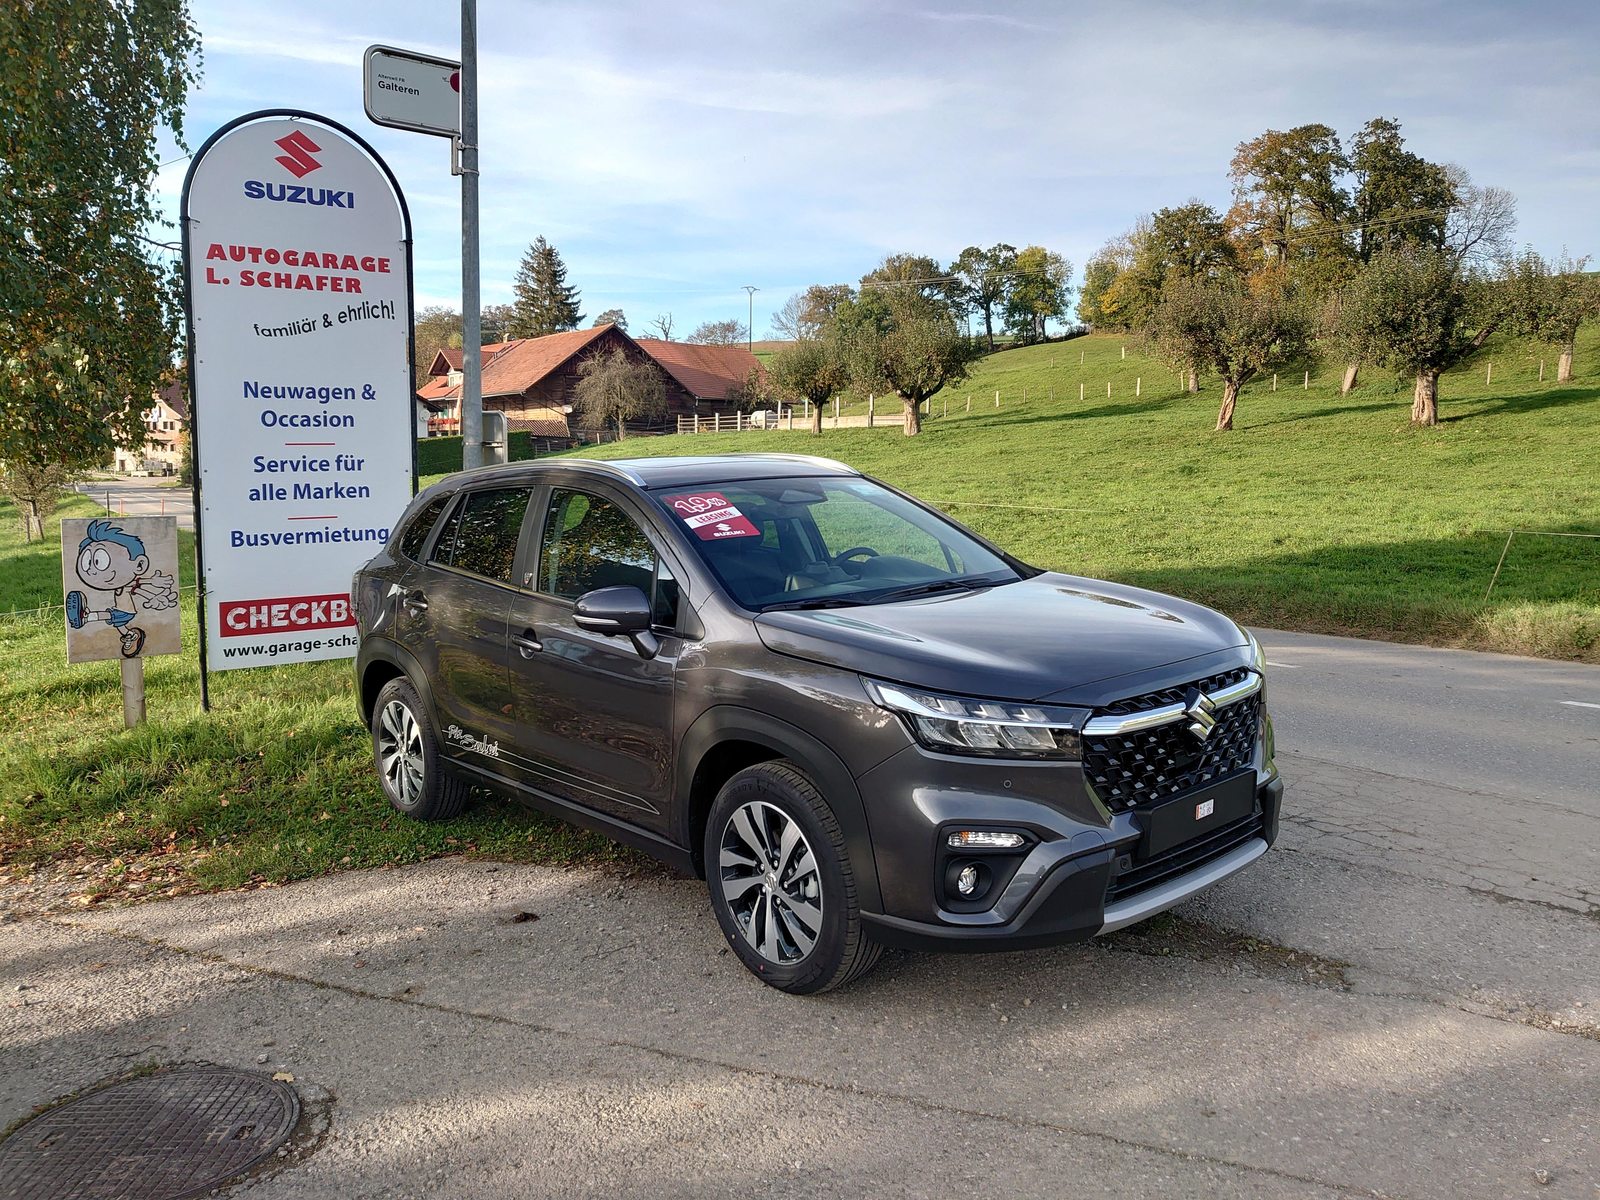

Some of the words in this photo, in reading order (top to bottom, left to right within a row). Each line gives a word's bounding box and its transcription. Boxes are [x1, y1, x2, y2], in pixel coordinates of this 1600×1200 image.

[378, 80, 420, 96] Galteren
[244, 180, 355, 209] SUZUKI
[206, 243, 391, 274] AUTOGARAGE
[206, 267, 230, 285] L.
[239, 270, 362, 294] SCHAFER
[253, 318, 317, 338] familiär
[322, 313, 334, 329] &
[337, 300, 396, 325] ehrlich!
[243, 381, 356, 404] Neuwagen
[361, 383, 377, 401] &
[260, 410, 355, 428] Occasion
[253, 455, 330, 473] Service
[335, 454, 365, 472] für
[248, 483, 287, 502] alle
[293, 482, 370, 501] Marken
[695, 510, 731, 523] LEASING
[231, 526, 390, 548] Busvermietung
[226, 598, 355, 631] CHECKB
